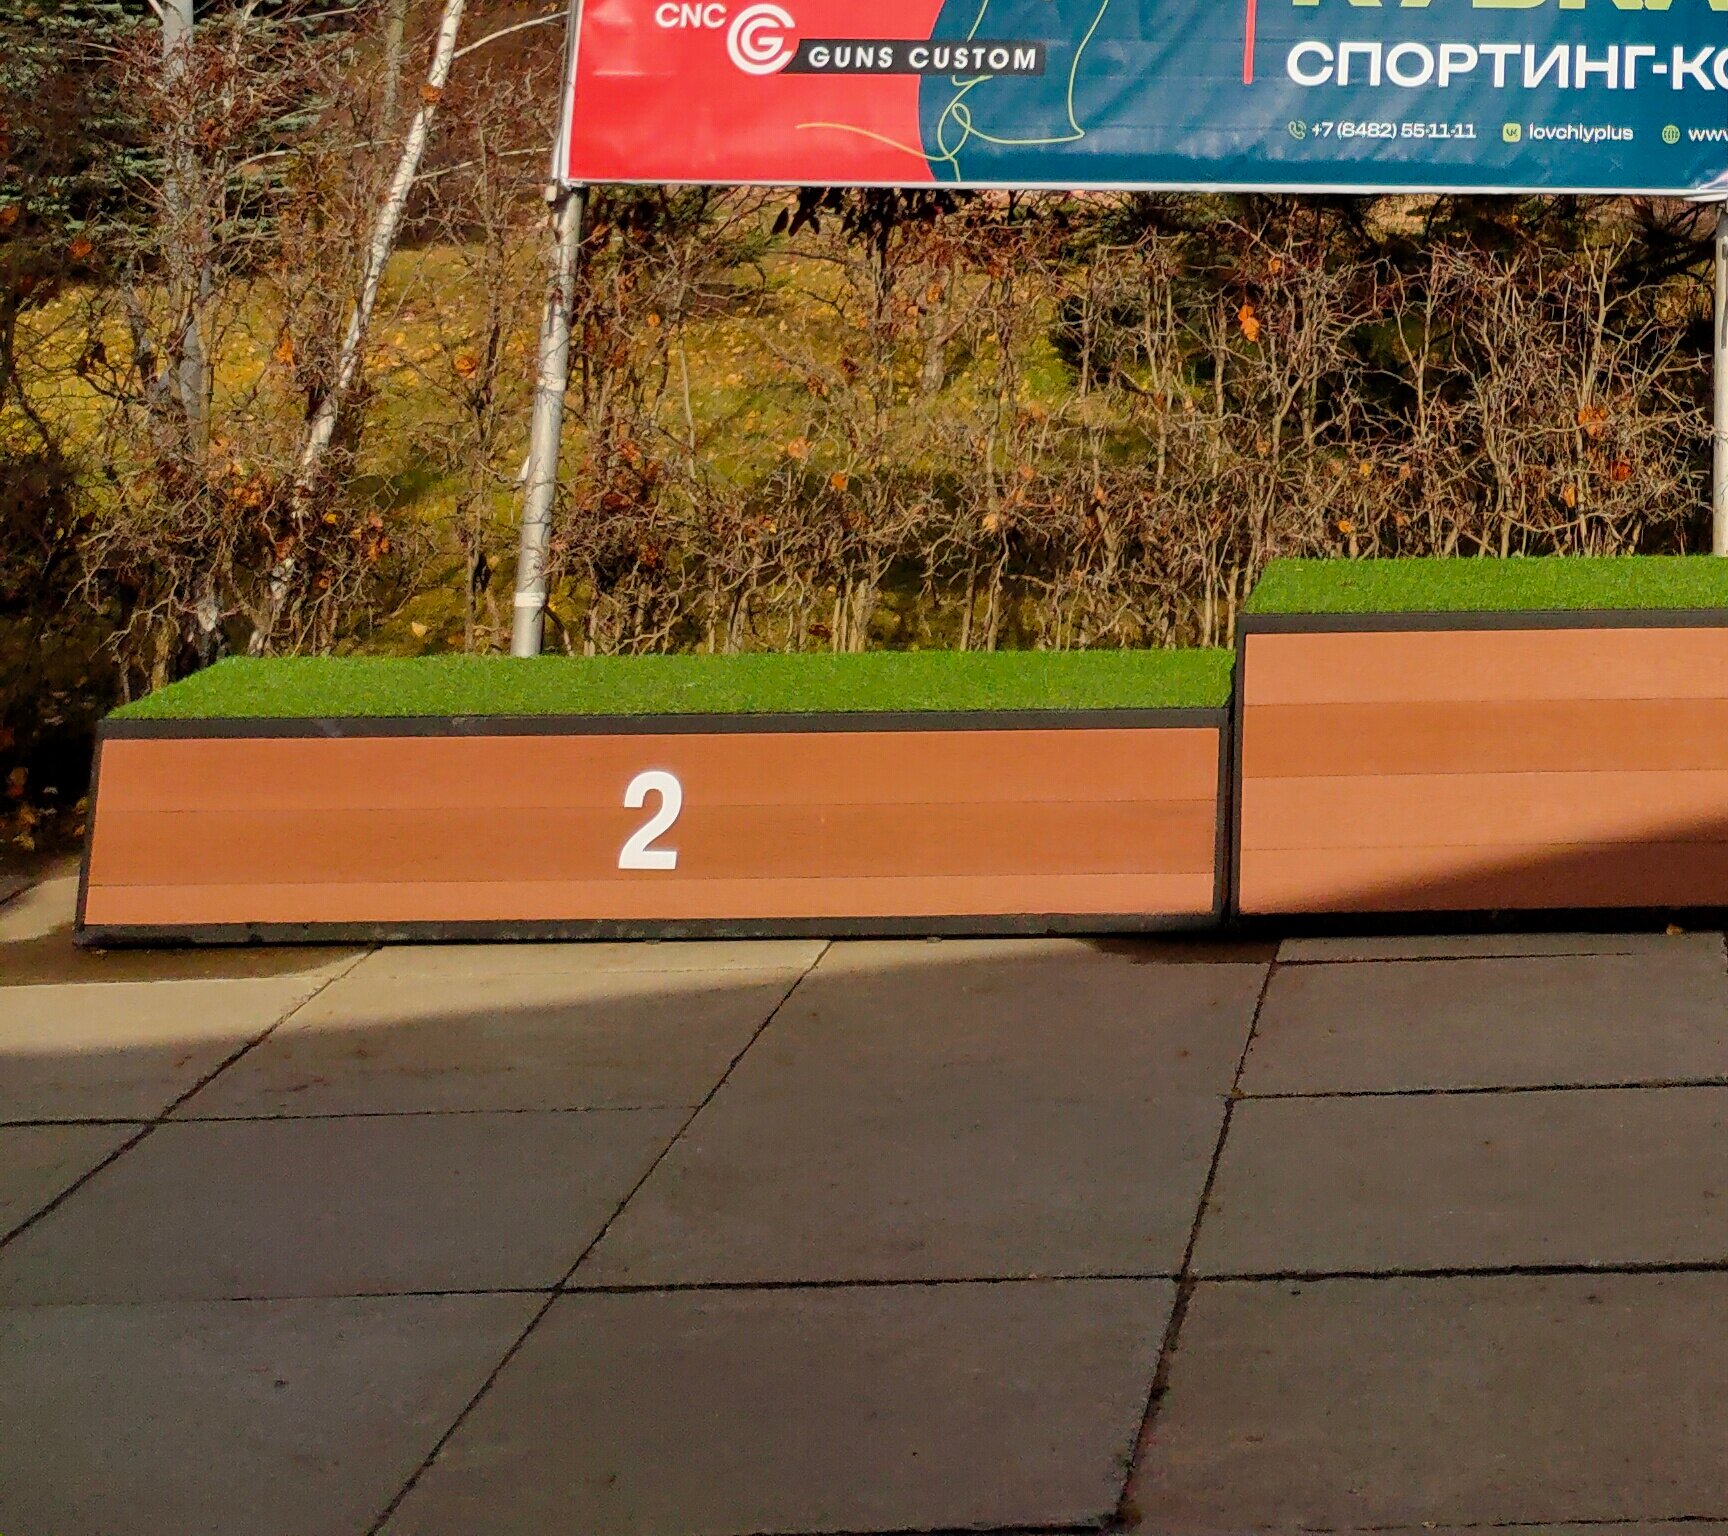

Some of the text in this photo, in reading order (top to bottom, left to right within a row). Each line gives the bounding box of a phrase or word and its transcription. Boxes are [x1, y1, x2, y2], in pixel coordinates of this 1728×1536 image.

[655, 2, 726, 28] CNC
[808, 46, 1036, 71] GUNS CUSTOM
[1311, 121, 1477, 141] +7 (8482) 55-11-11
[618, 770, 682, 870] 2
